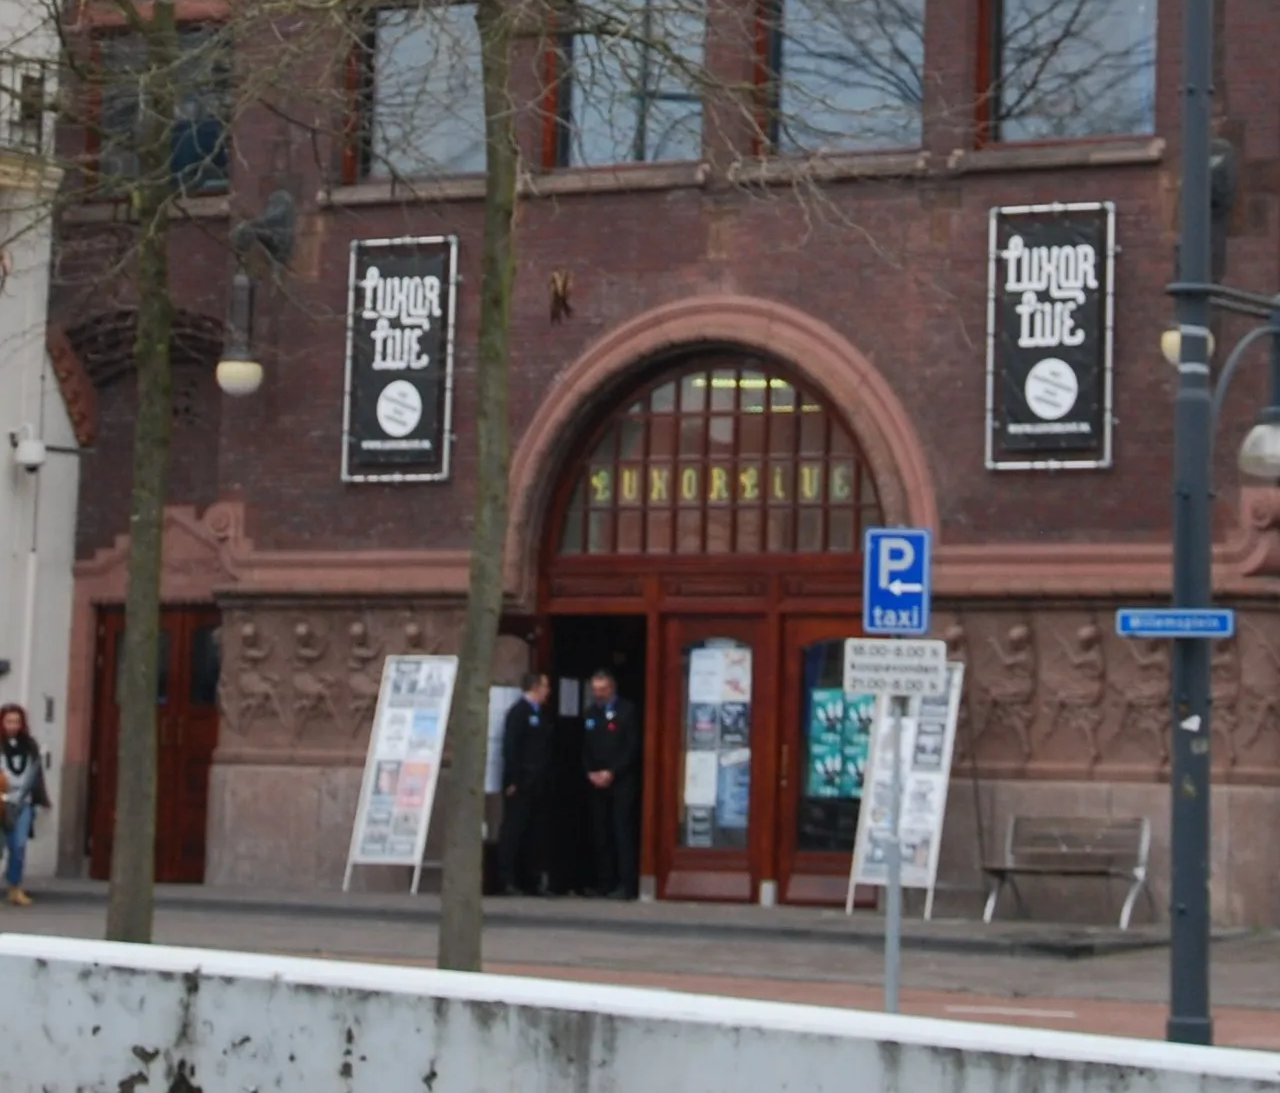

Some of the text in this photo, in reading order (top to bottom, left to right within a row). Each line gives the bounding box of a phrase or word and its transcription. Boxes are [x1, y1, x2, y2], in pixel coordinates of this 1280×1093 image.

[361, 266, 442, 330] LUXOR
[1001, 235, 1098, 304] LUXOR
[879, 538, 915, 589] P
[873, 605, 919, 627] taxi
